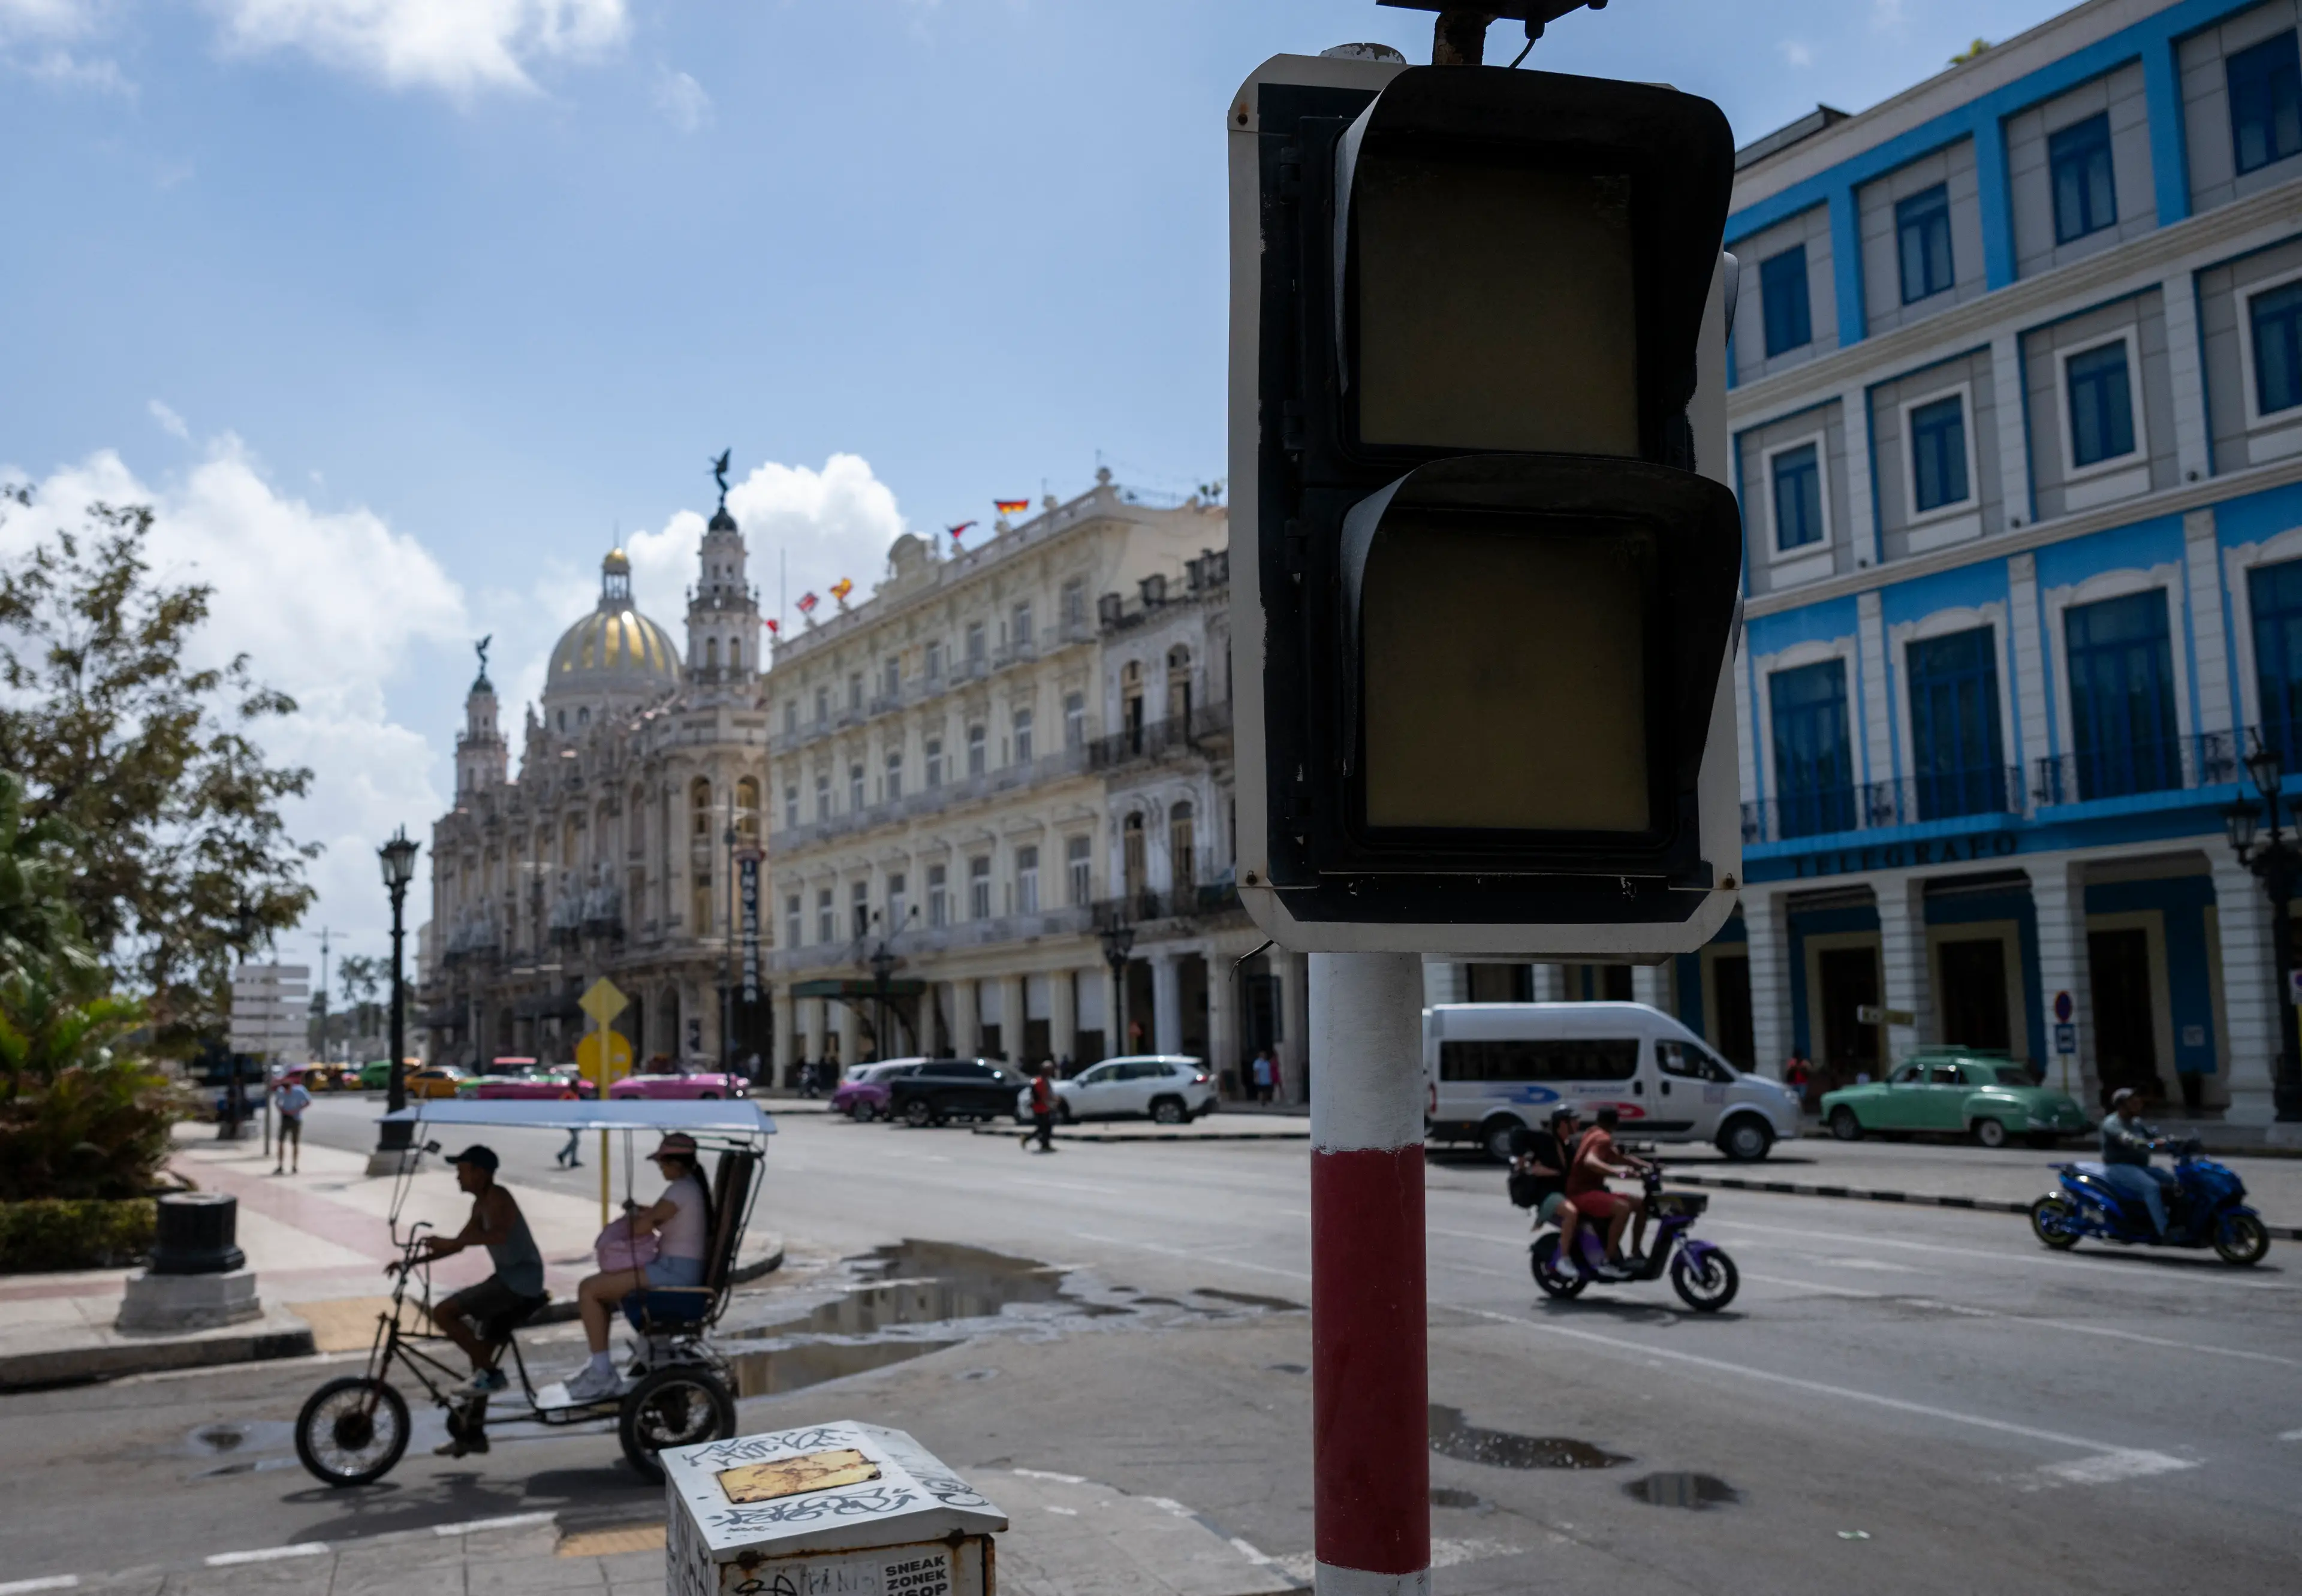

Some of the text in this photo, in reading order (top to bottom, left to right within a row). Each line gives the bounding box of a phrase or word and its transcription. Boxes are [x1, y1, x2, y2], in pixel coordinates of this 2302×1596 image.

[1794, 832, 2017, 877] TELEGRAFO
[885, 1555, 945, 1577] SNEAK
[886, 1568, 947, 1591] ZONEK
[888, 1582, 948, 1596] SOP
